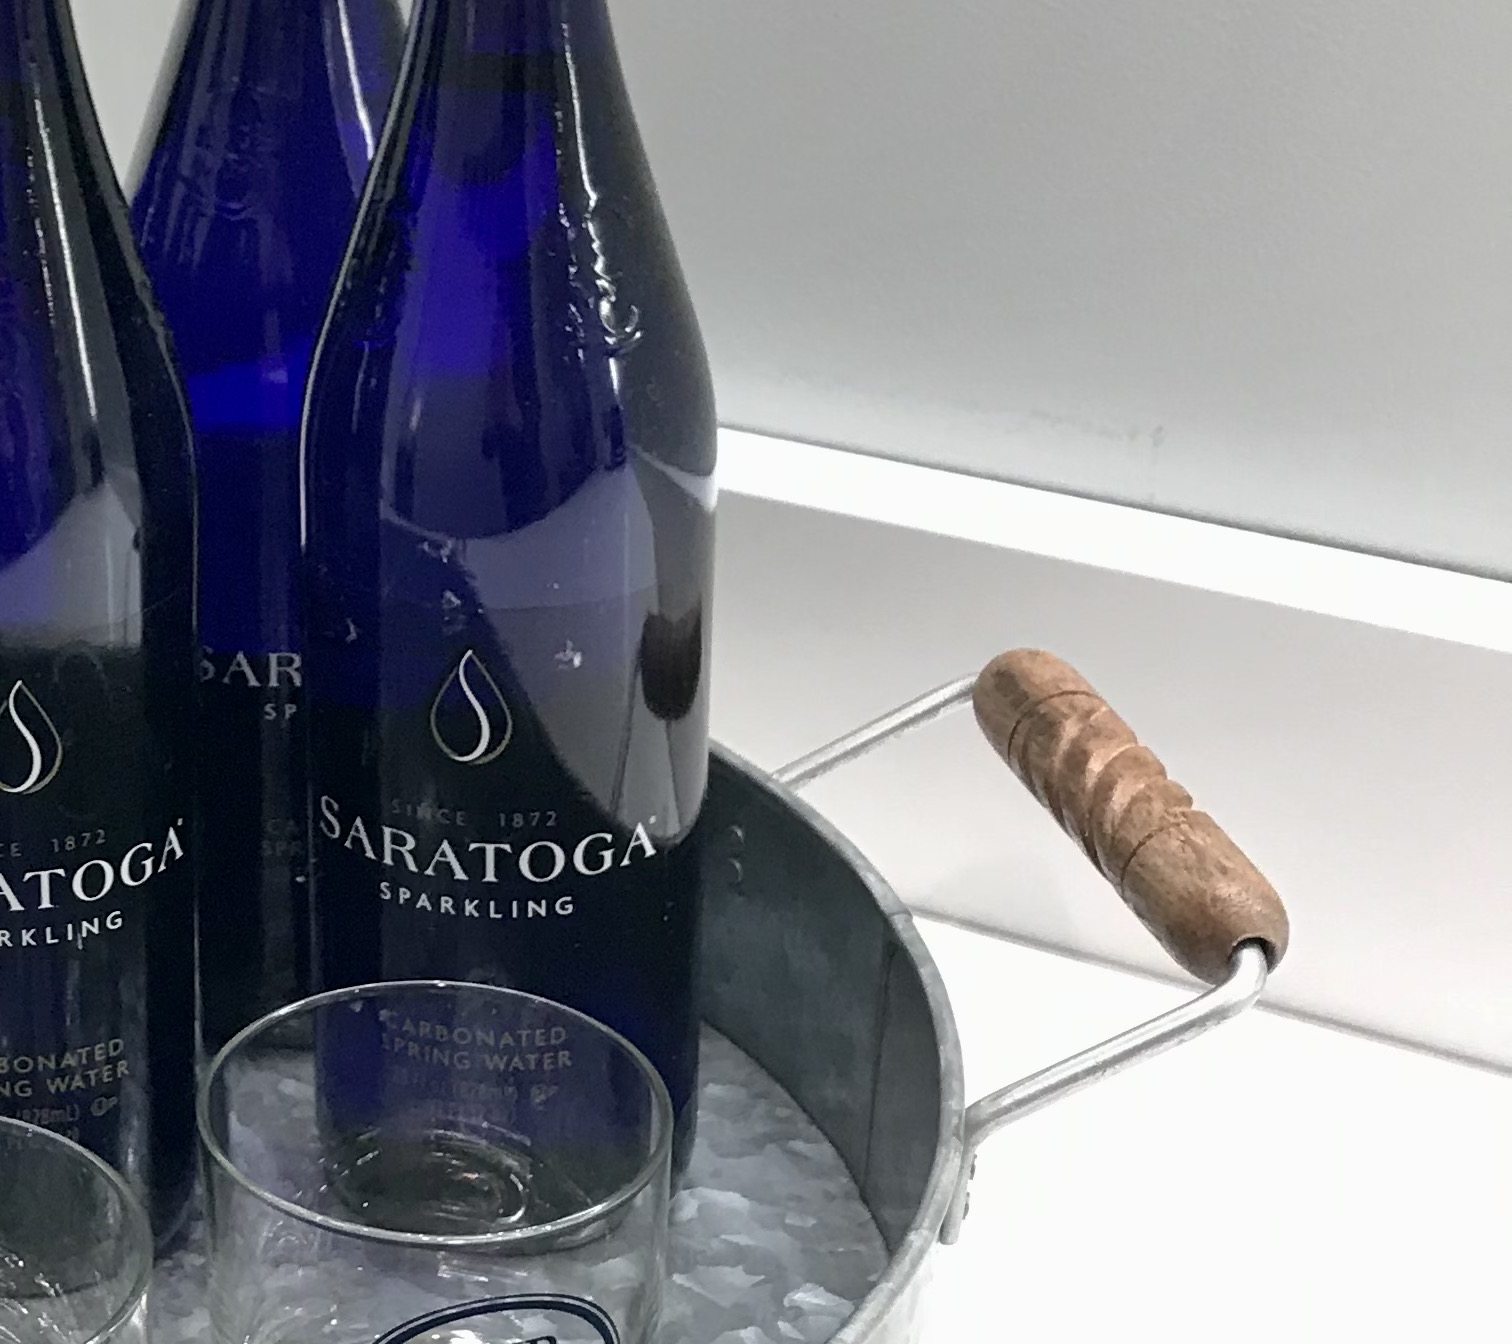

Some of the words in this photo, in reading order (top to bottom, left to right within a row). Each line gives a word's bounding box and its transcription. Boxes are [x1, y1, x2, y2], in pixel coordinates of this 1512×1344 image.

[498, 809, 559, 828] 1872
[49, 828, 107, 855] 1872
[319, 795, 657, 884] SARATOGA
[379, 881, 575, 919] SPARKLING
[384, 1012, 568, 1048] CARBONATED
[381, 1033, 472, 1070] SPRING
[482, 1050, 573, 1072] WATER
[46, 1060, 130, 1096] WATER
